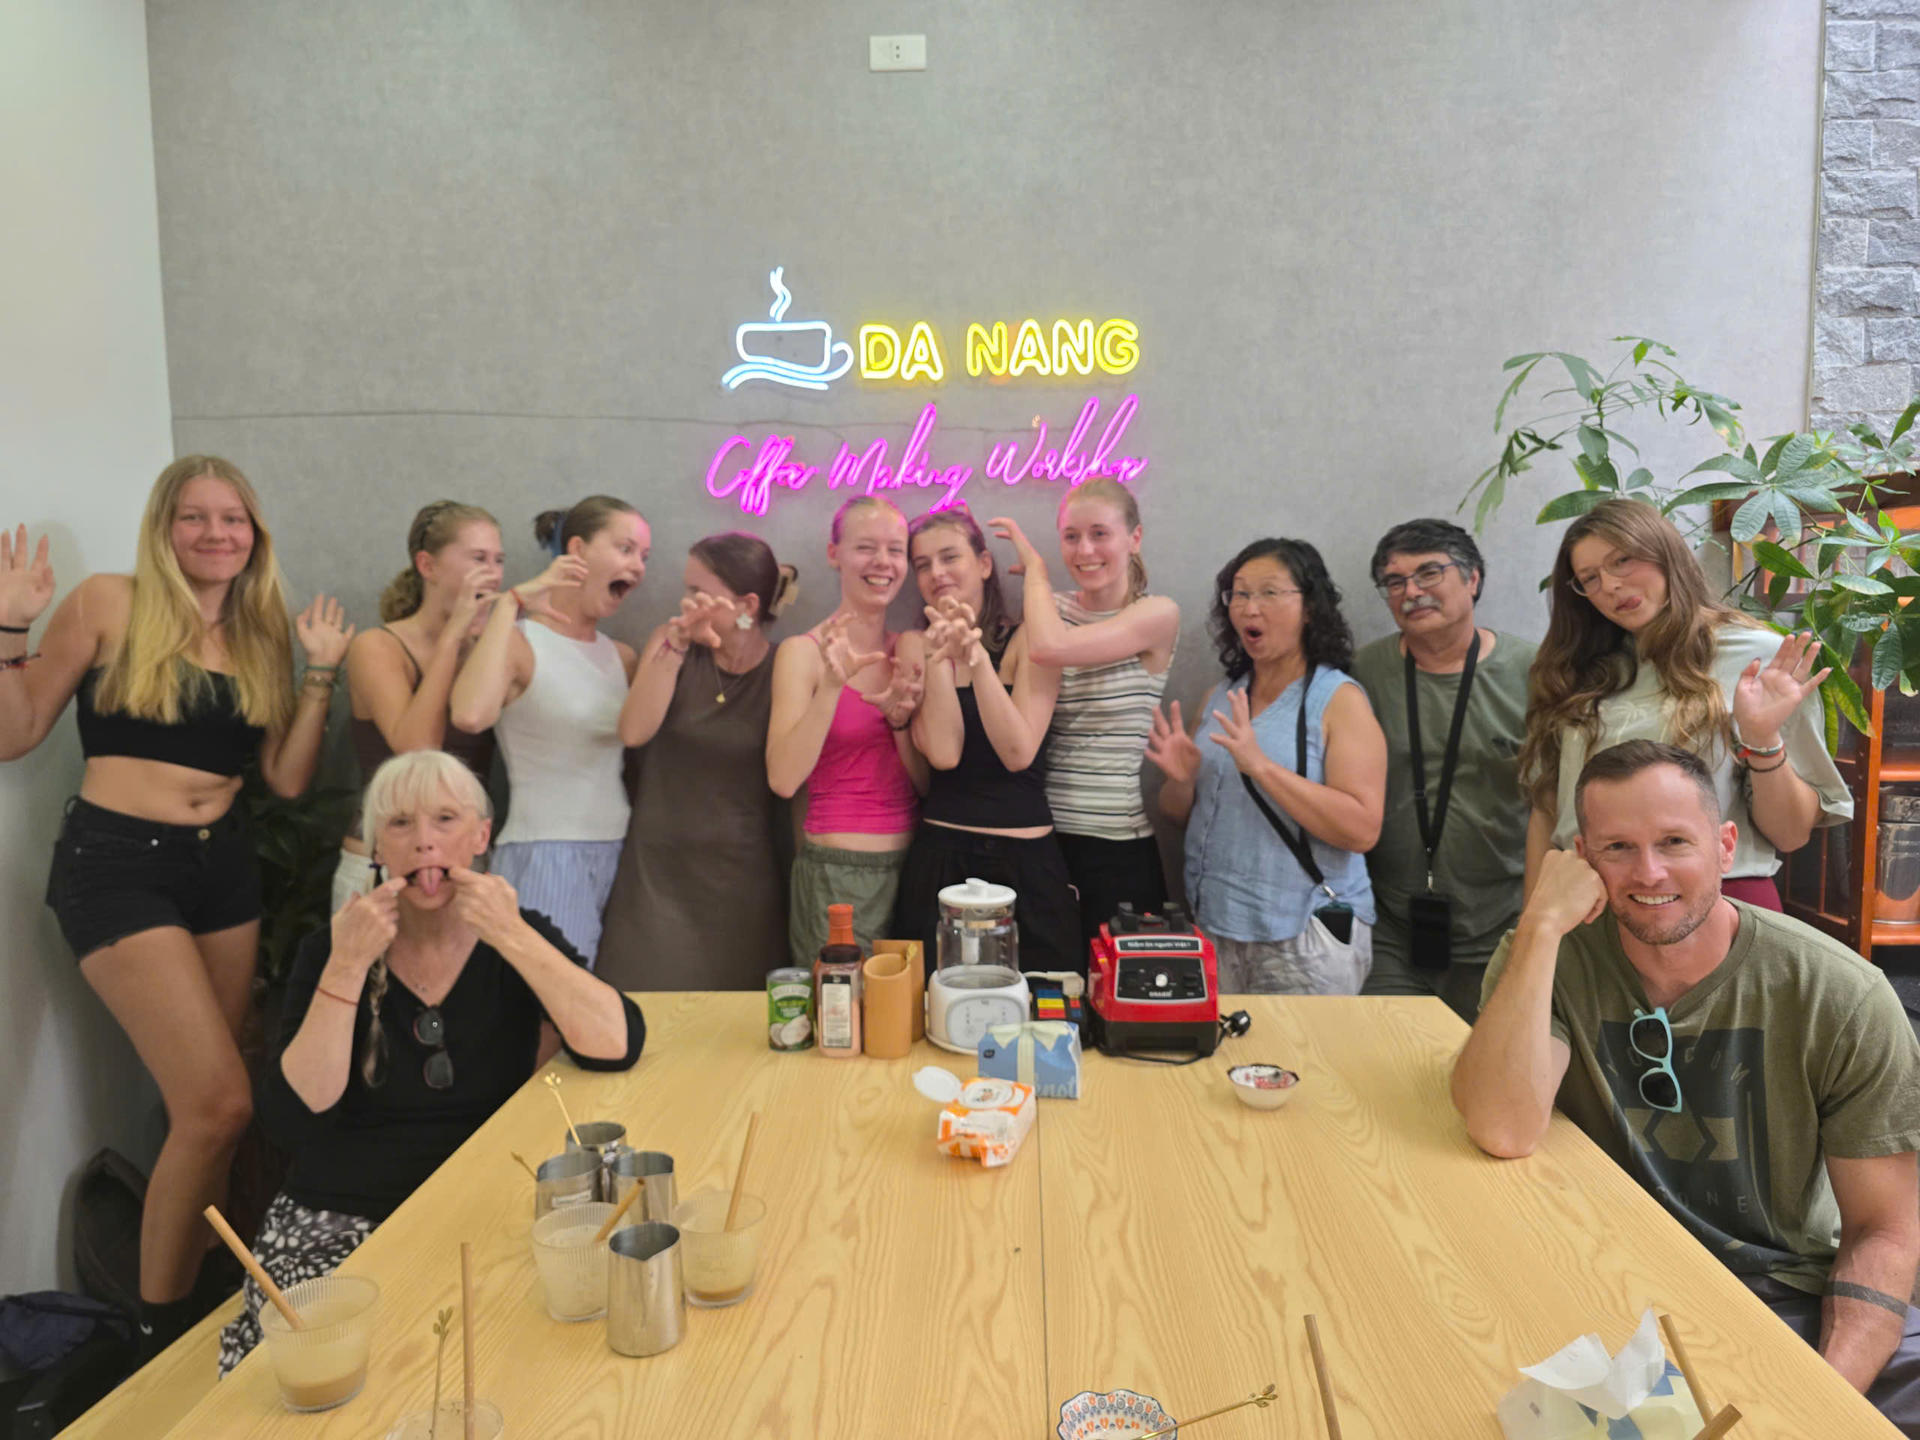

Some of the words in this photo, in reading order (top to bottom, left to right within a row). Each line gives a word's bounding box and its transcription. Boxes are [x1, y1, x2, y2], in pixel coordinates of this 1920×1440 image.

[859, 321, 943, 381] DA
[966, 318, 1140, 376] NANG
[706, 434, 819, 517] Coffee
[827, 402, 973, 514] Making
[985, 393, 1148, 487] Workshop
